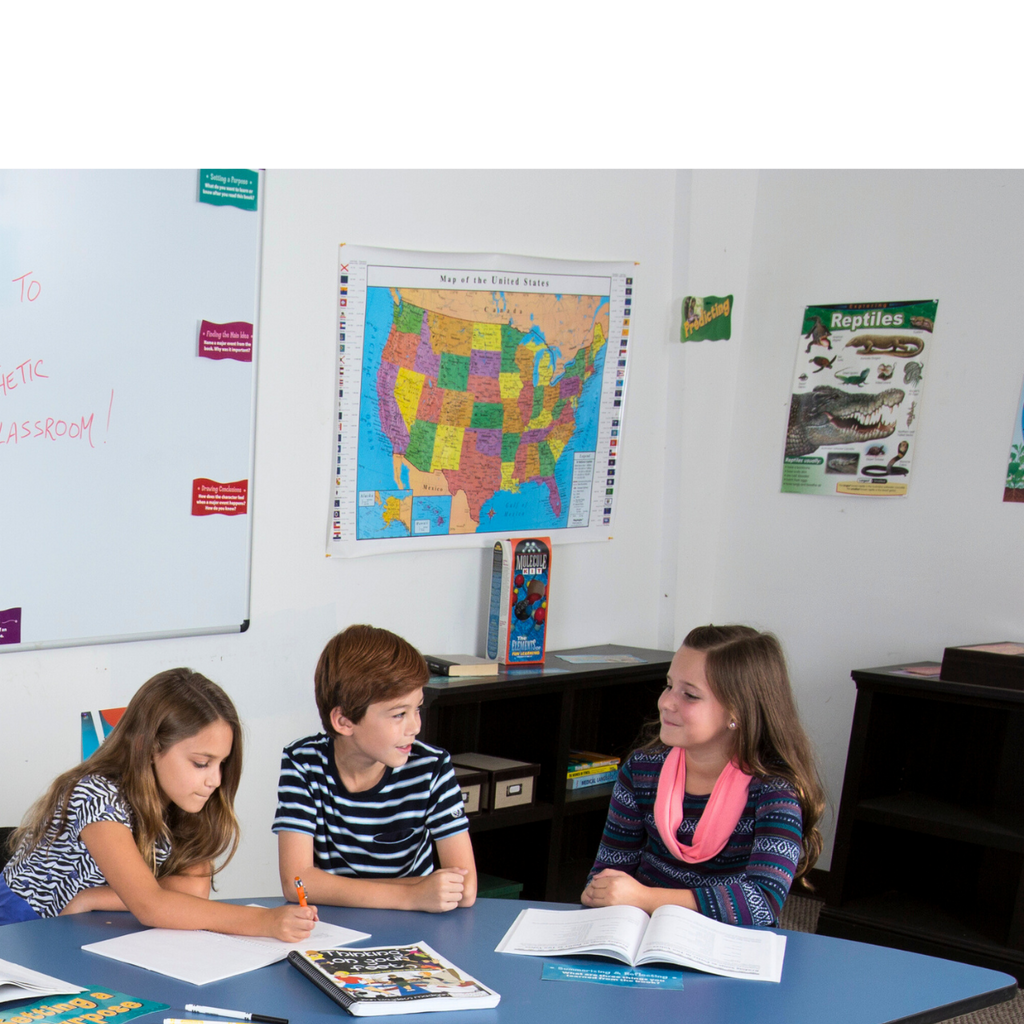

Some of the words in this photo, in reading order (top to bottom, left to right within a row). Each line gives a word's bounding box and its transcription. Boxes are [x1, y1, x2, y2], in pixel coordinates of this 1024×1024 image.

[12, 272, 41, 302] TO
[440, 275, 456, 284] Map
[492, 276, 520, 286] United
[524, 278, 550, 287] States
[484, 306, 522, 314] Canada
[684, 298, 730, 338] Predicting
[831, 311, 904, 330] Reptiles
[423, 484, 444, 492] Mexico
[516, 554, 548, 570] MOLECULE
